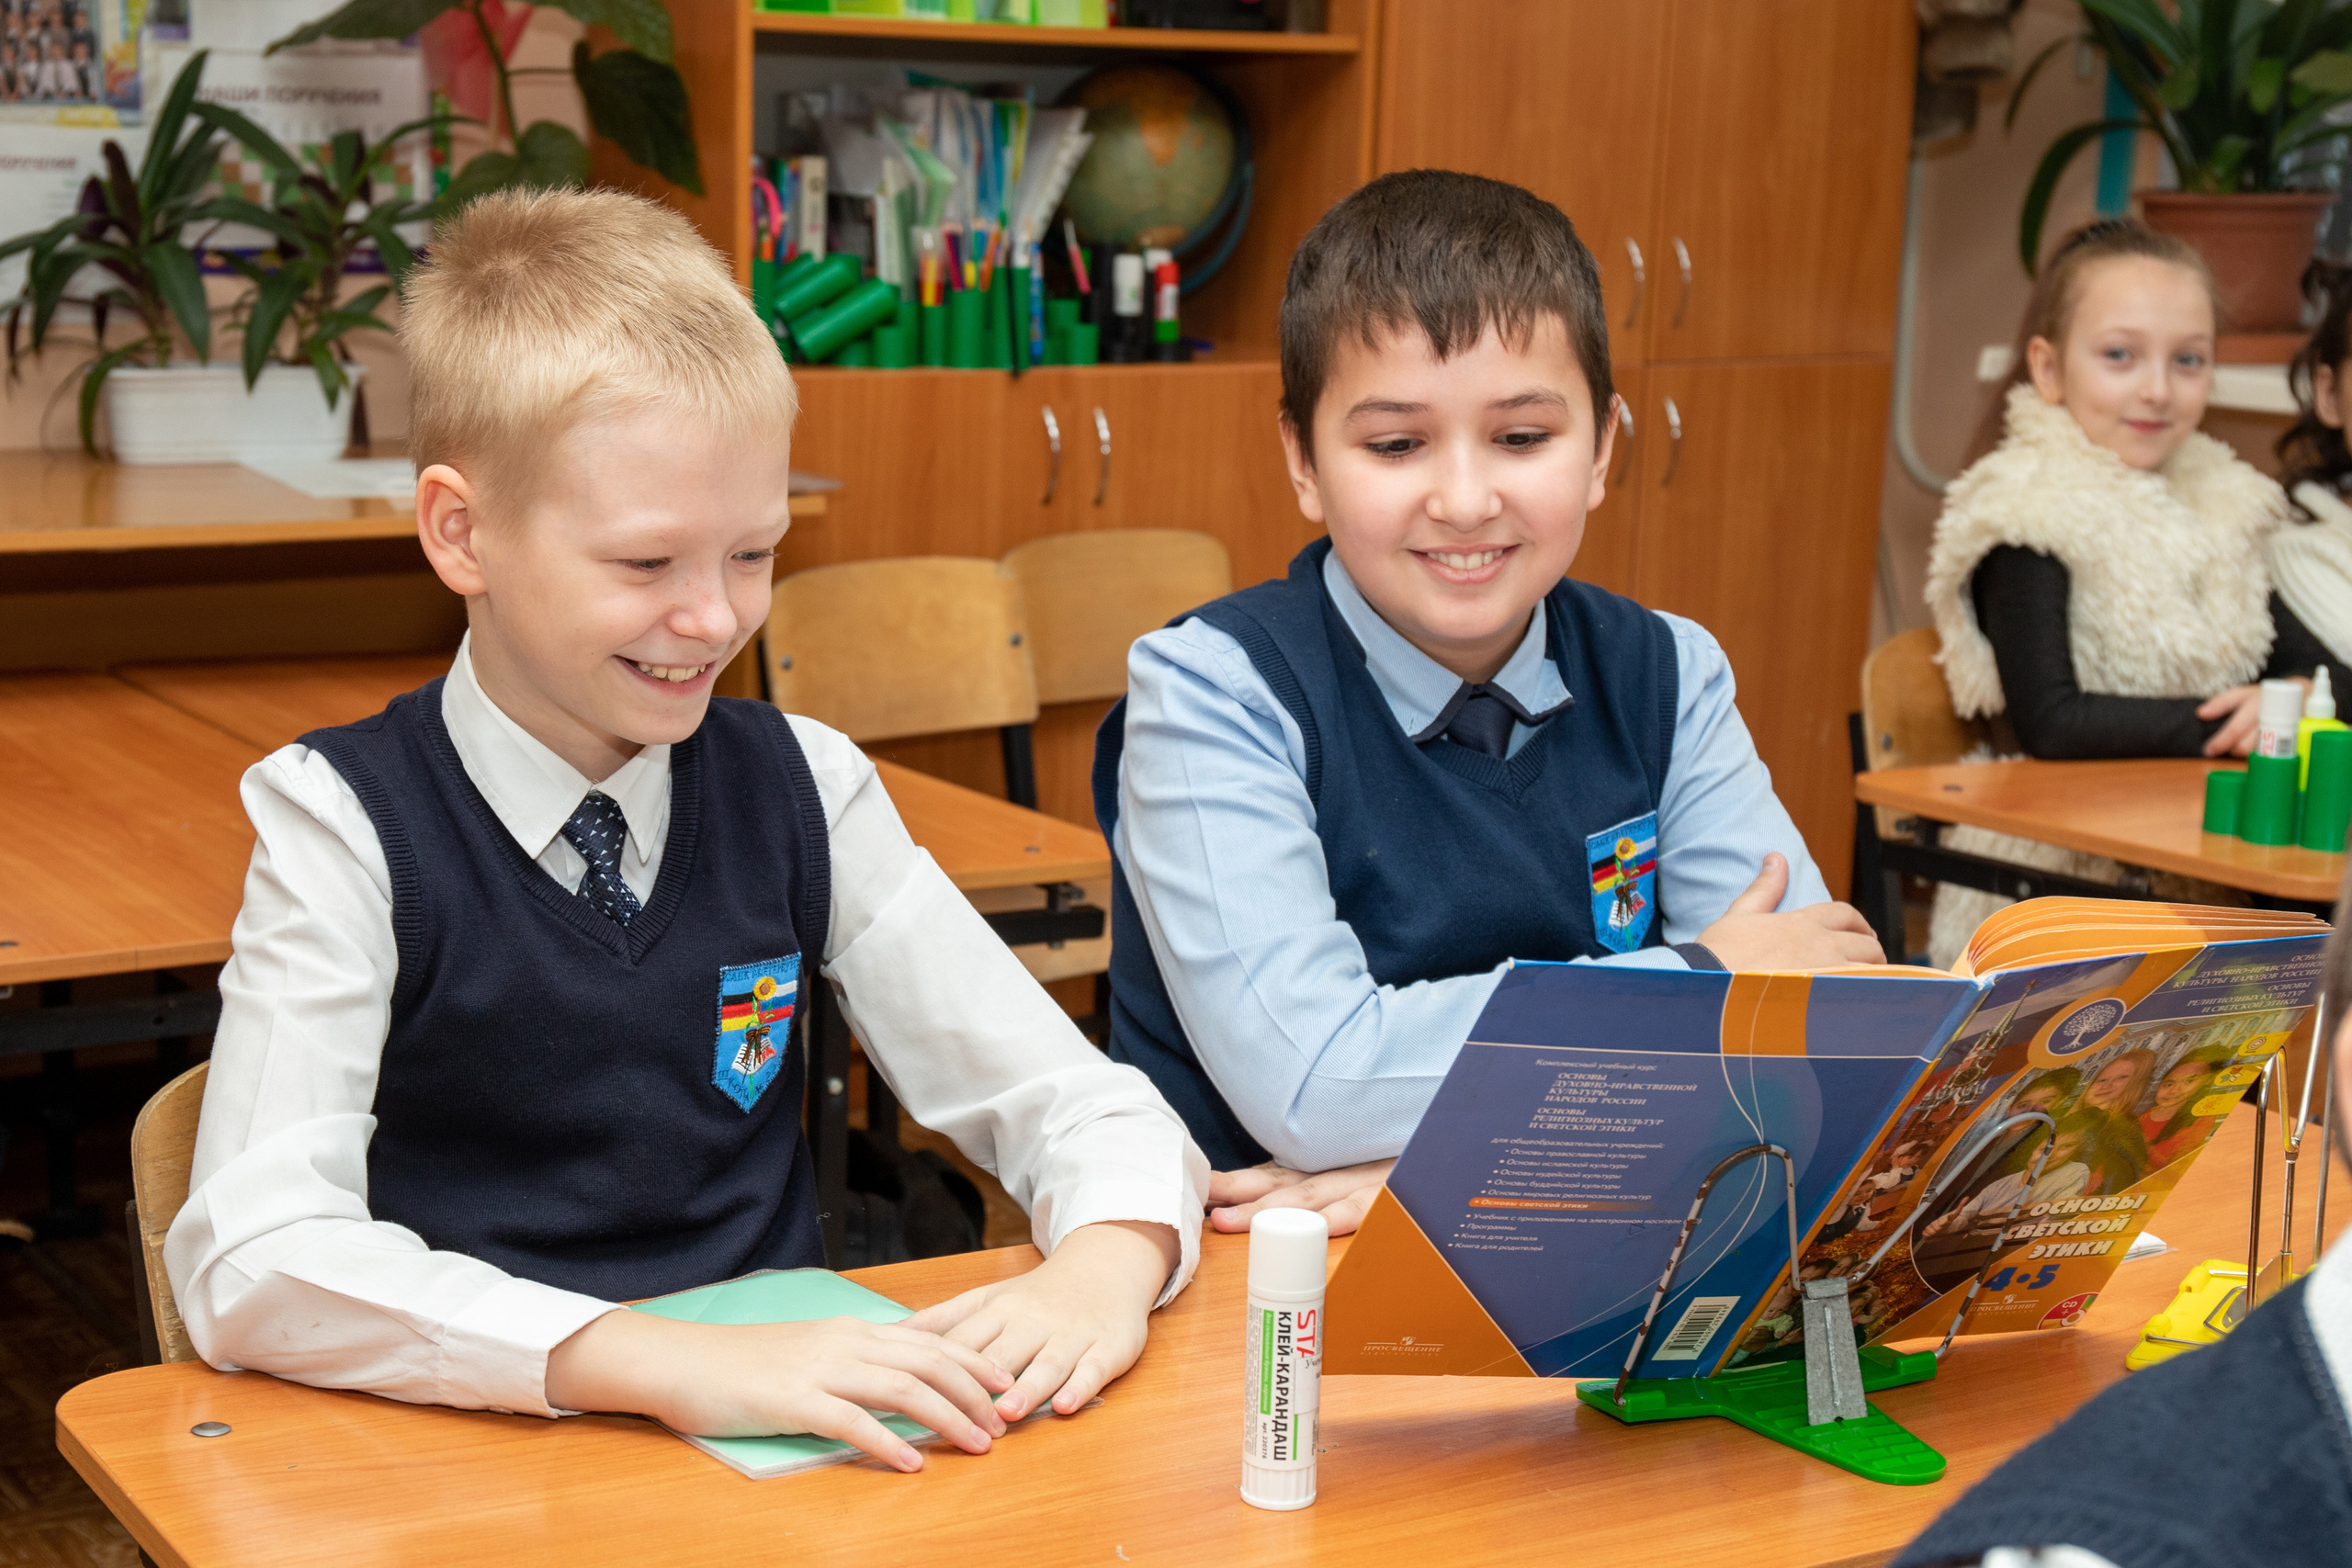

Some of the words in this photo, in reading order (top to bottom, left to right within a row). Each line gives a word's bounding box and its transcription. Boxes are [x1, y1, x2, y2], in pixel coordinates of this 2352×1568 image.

[2291, 953, 2327, 962] ОСНОВ
[2197, 961, 2324, 978] ДУХОВНО-НРАВСТВЕННО
[2173, 976, 2228, 988] КУЛЬТУРЫ
[2231, 973, 2278, 983] НАРОДОВ
[2281, 968, 2322, 978] РОССИИ
[2268, 982, 2312, 992] ОСНОВЫ
[2187, 994, 2259, 1007] РЕЛИГИОЗНЫХ
[2261, 989, 2305, 1000] КУЛЬТУР
[2209, 1000, 2264, 1012] СВЕТСКОЙ
[2266, 998, 2299, 1007] ЭТИКИ
[1535, 1059, 1597, 1068] Комплексный
[1598, 1062, 1635, 1072] учебный
[1637, 1064, 1657, 1072] курс
[1557, 1072, 1607, 1081] ОСНОВЫ
[1552, 1080, 1698, 1091] ДУХОВНО-НРАВСТВЕННОЙ
[1548, 1088, 1609, 1096] КУЛЬТУРЫ
[1544, 1095, 1597, 1104] НАРОДОВ
[1537, 1107, 1587, 1116] ОСНОВЫ
[1532, 1114, 1611, 1124] РЕЛИГИОЗНЫХ
[1614, 1118, 1664, 1126] КУЛЬТУР
[1539, 1122, 1597, 1132] СВЕТСКОЙ
[1510, 1138, 1609, 1147] общеобразовательных
[1510, 1148, 1544, 1156] Основы
[1545, 1150, 1606, 1158] православной
[1507, 1158, 1541, 1167] Основы
[1500, 1168, 1534, 1177] Основы
[1494, 1179, 1528, 1187] Основы
[1529, 1180, 1580, 1189] буддийской
[1487, 1189, 1521, 1197] Основы
[1481, 1199, 1517, 1207] Основы
[1519, 1201, 1561, 1209] светской
[2030, 1195, 2148, 1217] ОСНОВЫ
[1474, 1213, 1510, 1222] Учебник
[1467, 1223, 1517, 1231] Программы
[2004, 1214, 2132, 1240] СВЕТСКОЙ
[1461, 1233, 1486, 1241] Книга
[2028, 1241, 2115, 1260] ЭТИКИ
[2062, 1301, 2078, 1309] CD
[1296, 1309, 1317, 1358] STA
[1272, 1312, 1293, 1461] КЛЕЙ-КАРАНДАШ
